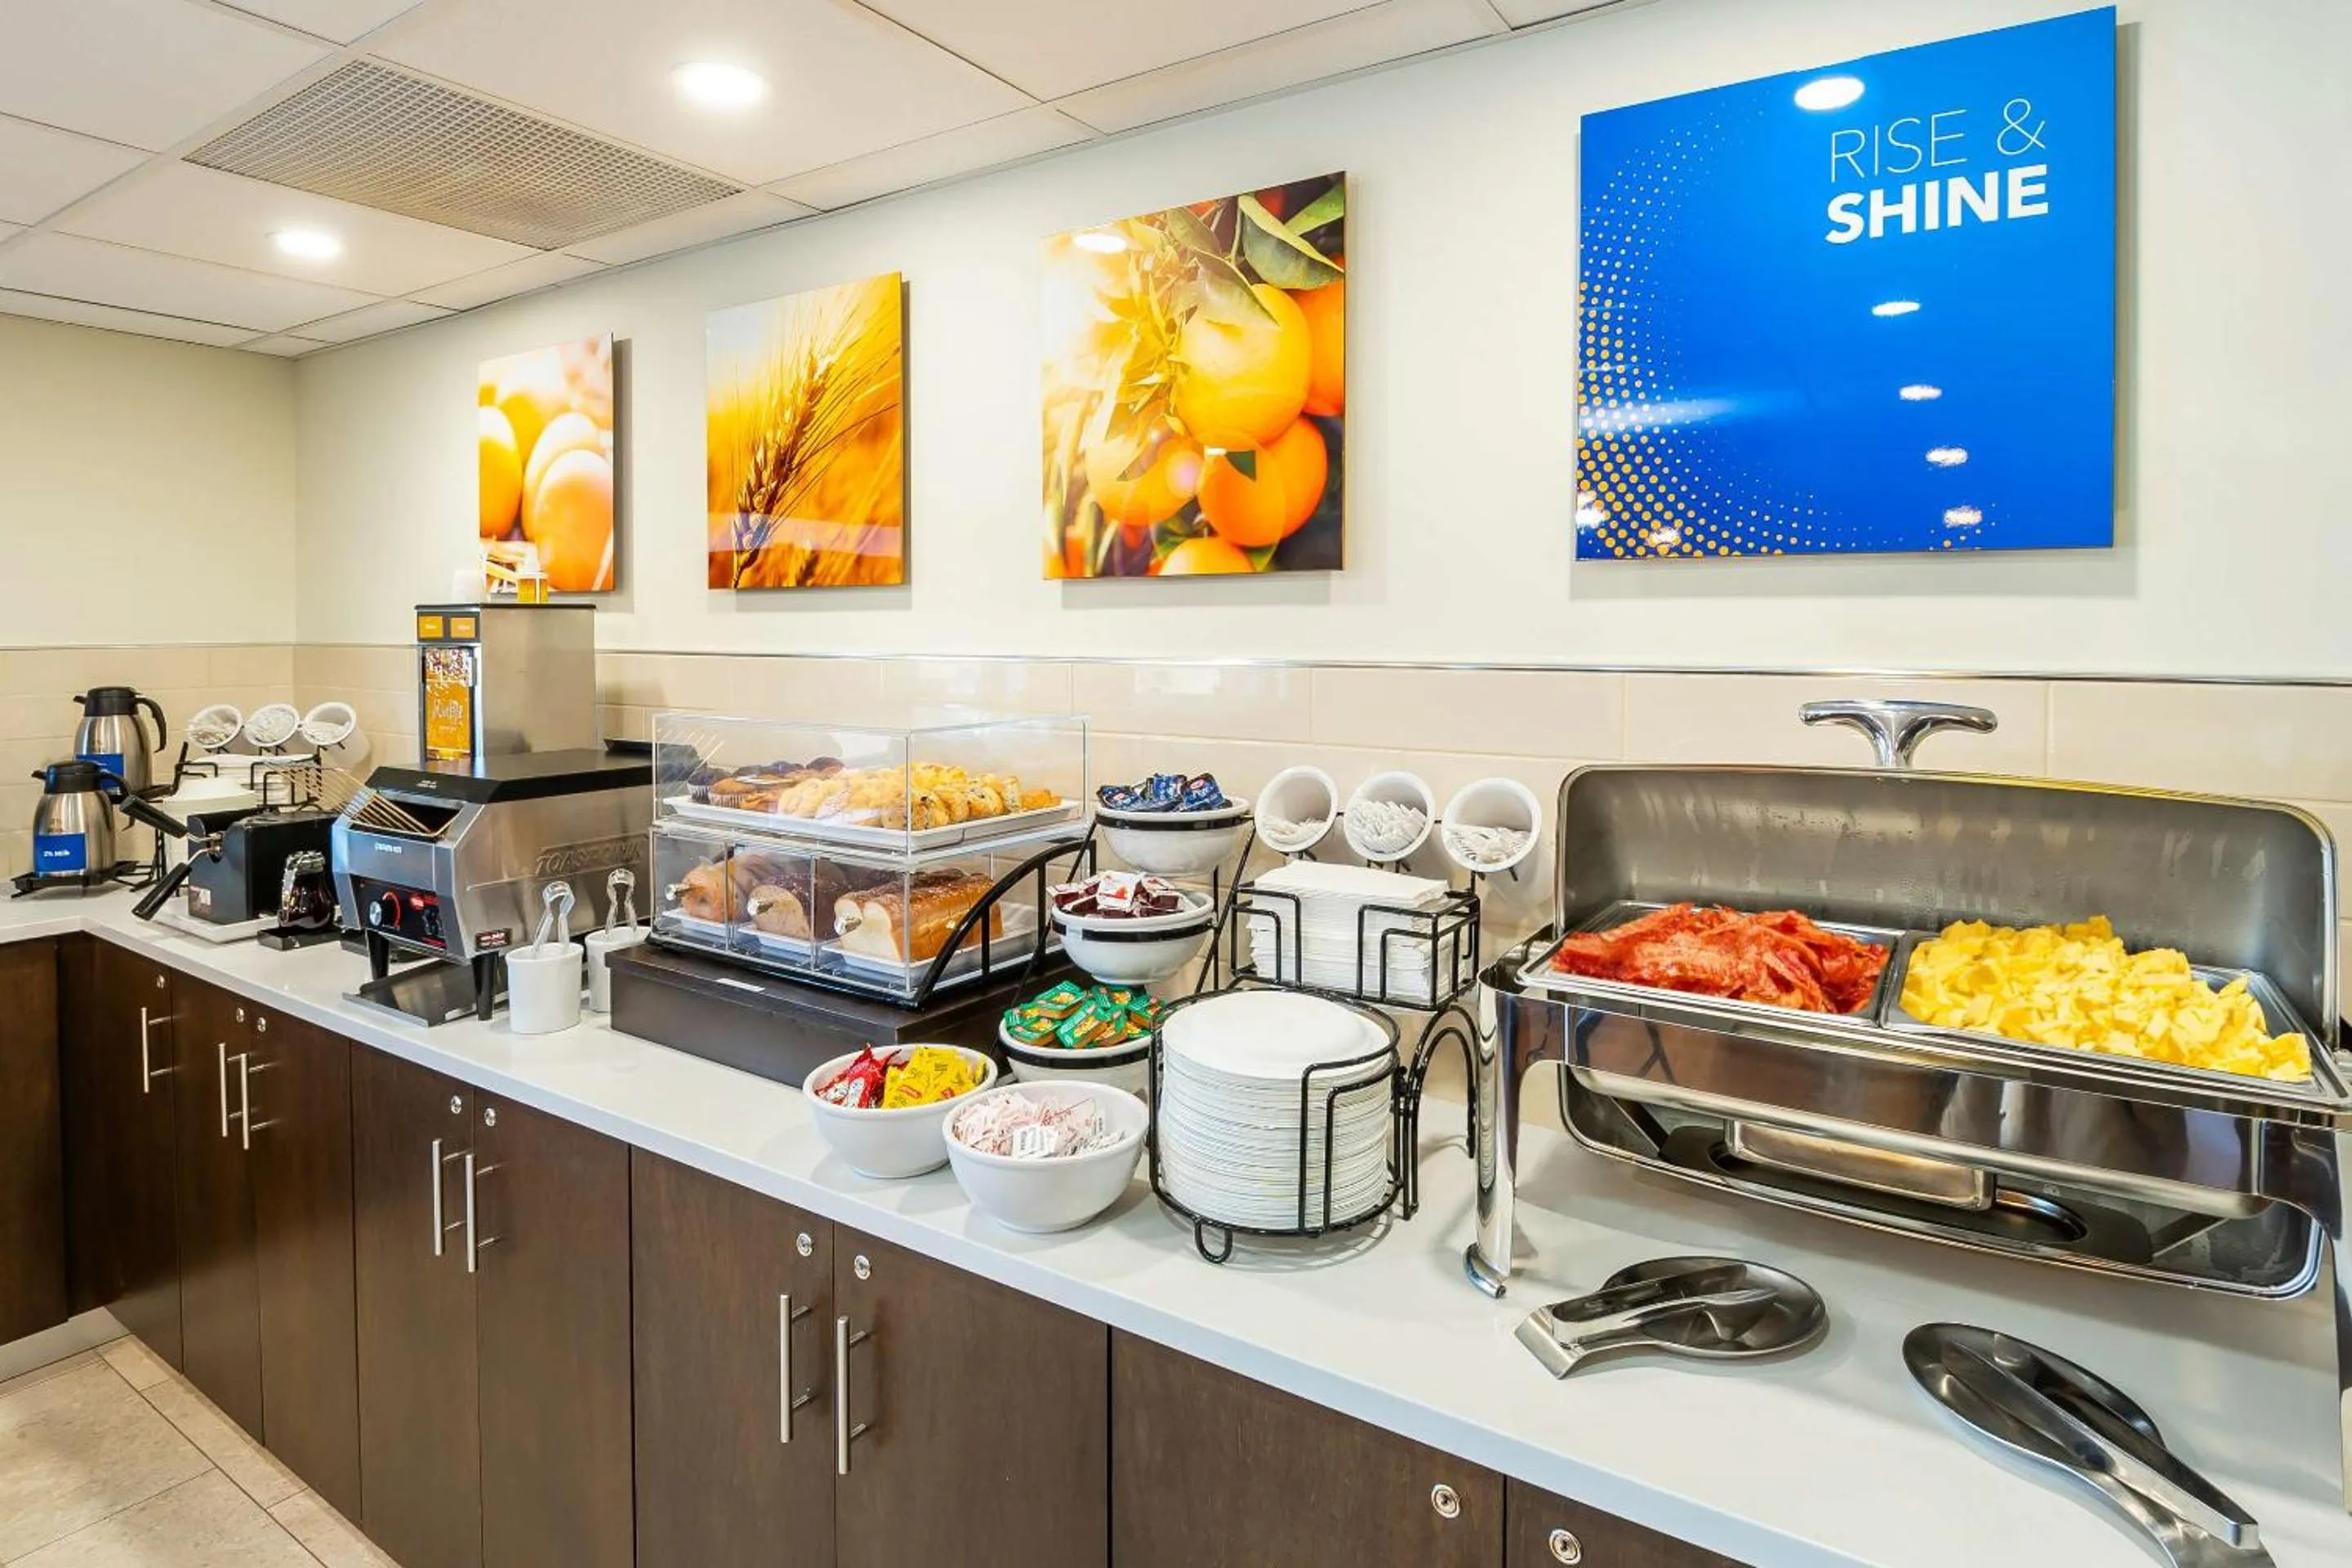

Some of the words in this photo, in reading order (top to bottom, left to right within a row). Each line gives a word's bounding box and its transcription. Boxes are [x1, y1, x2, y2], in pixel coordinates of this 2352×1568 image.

[1830, 109, 1967, 183] RISE
[1997, 98, 2046, 155] &
[1824, 163, 2049, 244] SHINE
